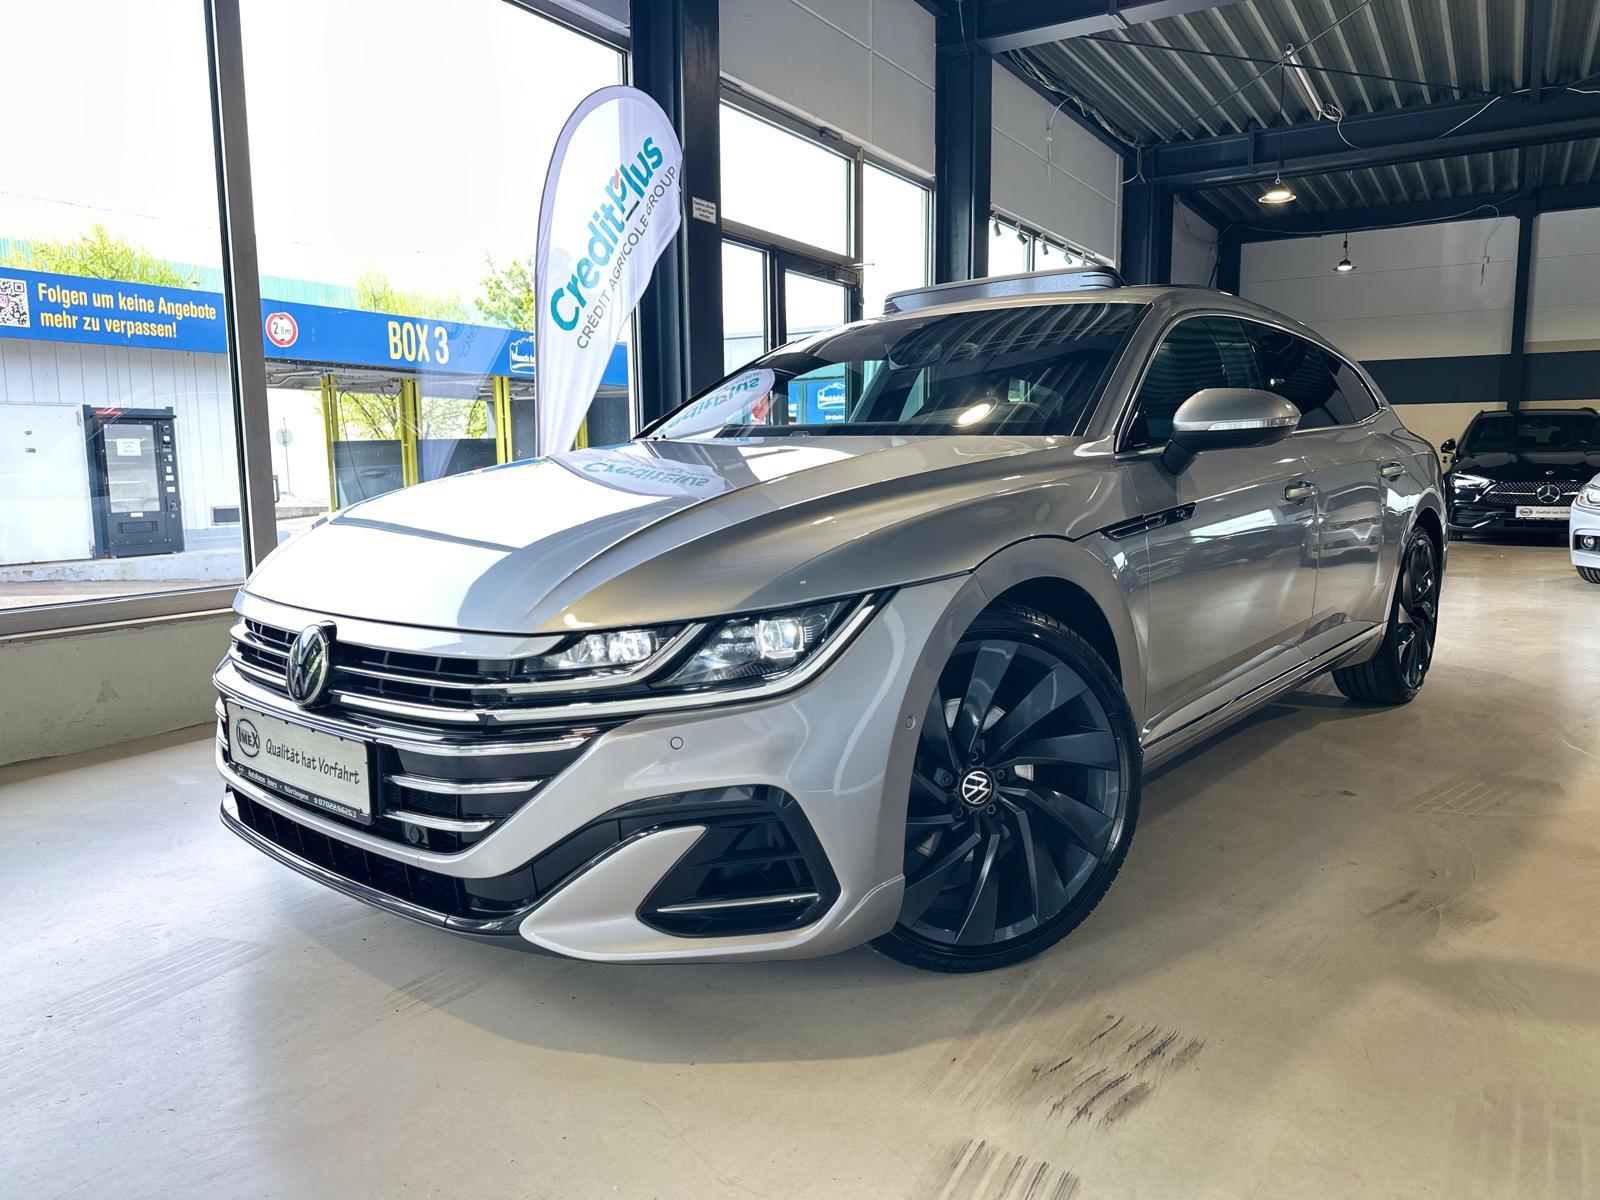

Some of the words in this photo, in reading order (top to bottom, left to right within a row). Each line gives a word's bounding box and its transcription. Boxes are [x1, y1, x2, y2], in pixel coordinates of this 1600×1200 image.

[577, 290, 611, 349] CRÉDIT
[609, 214, 650, 292] AGRICOLE
[646, 166, 676, 216] GROUP
[38, 282, 88, 307] Folgen
[92, 292, 115, 309] um
[118, 291, 155, 313] keine
[158, 296, 217, 320] Angebote
[40, 310, 79, 330] mehr
[83, 315, 100, 332] zu
[104, 319, 178, 339] verpassen!
[387, 320, 431, 363] BOX
[434, 326, 450, 365] 3
[265, 738, 300, 765] Qualität
[301, 750, 317, 771] hat
[318, 756, 360, 785] Vorfahrt
